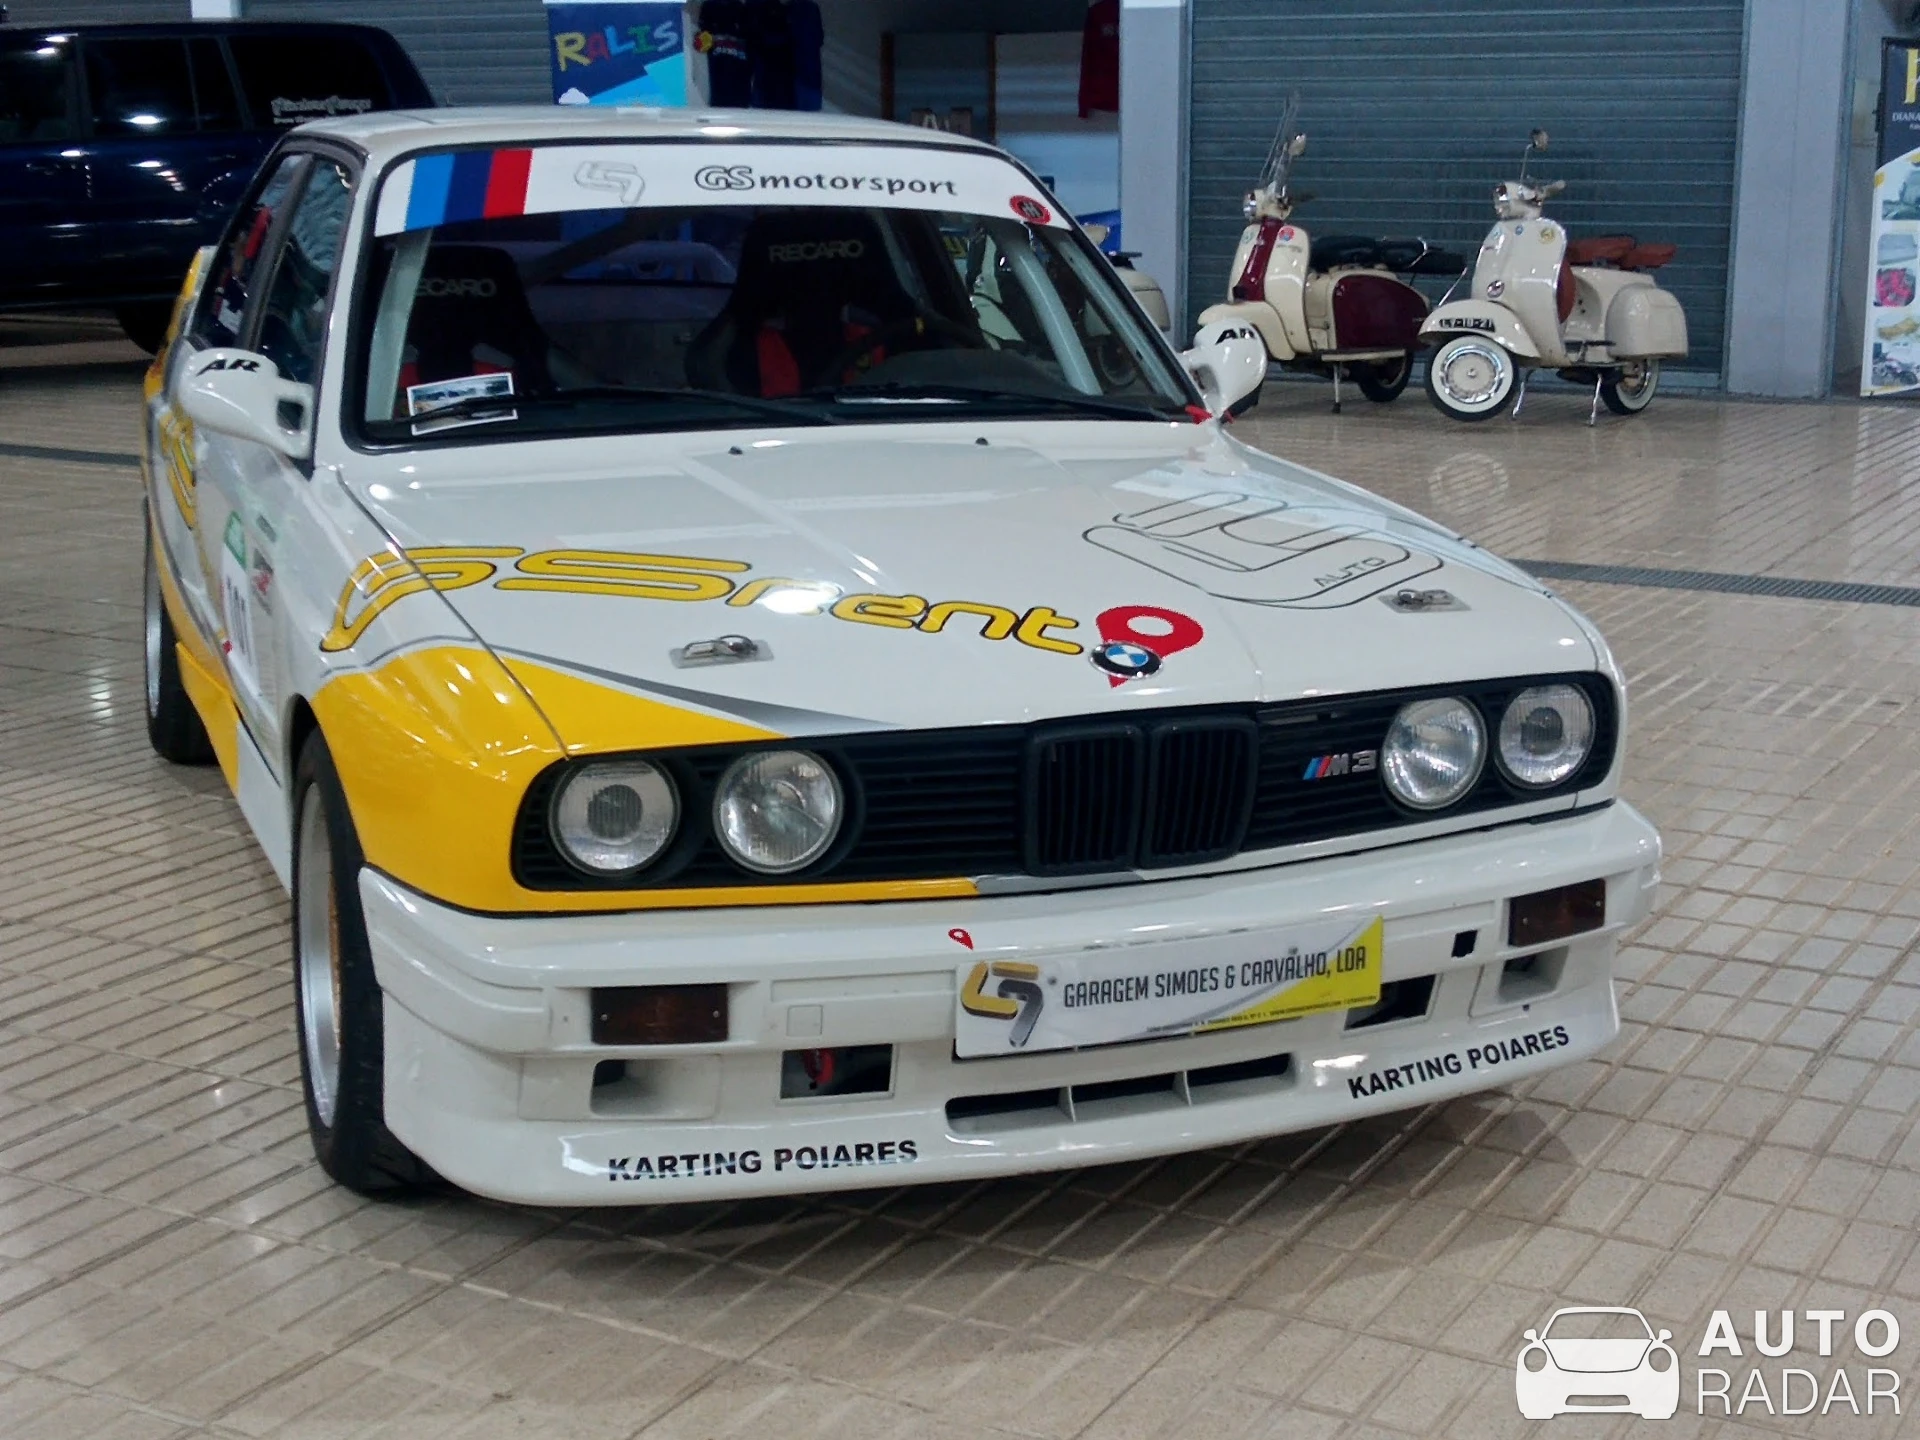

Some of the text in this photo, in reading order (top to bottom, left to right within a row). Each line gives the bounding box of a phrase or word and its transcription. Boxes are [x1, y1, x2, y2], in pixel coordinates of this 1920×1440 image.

[554, 20, 679, 72] RALIS
[768, 239, 863, 262] RECARO
[195, 359, 261, 376] AR
[1313, 556, 1386, 587] AUTO
[1064, 945, 1367, 1008] GARAGEM SIMOES & CARVALHO, LDA
[1347, 1025, 1570, 1099] KARTING POIARES
[608, 1139, 919, 1182] KARTING POIARES
